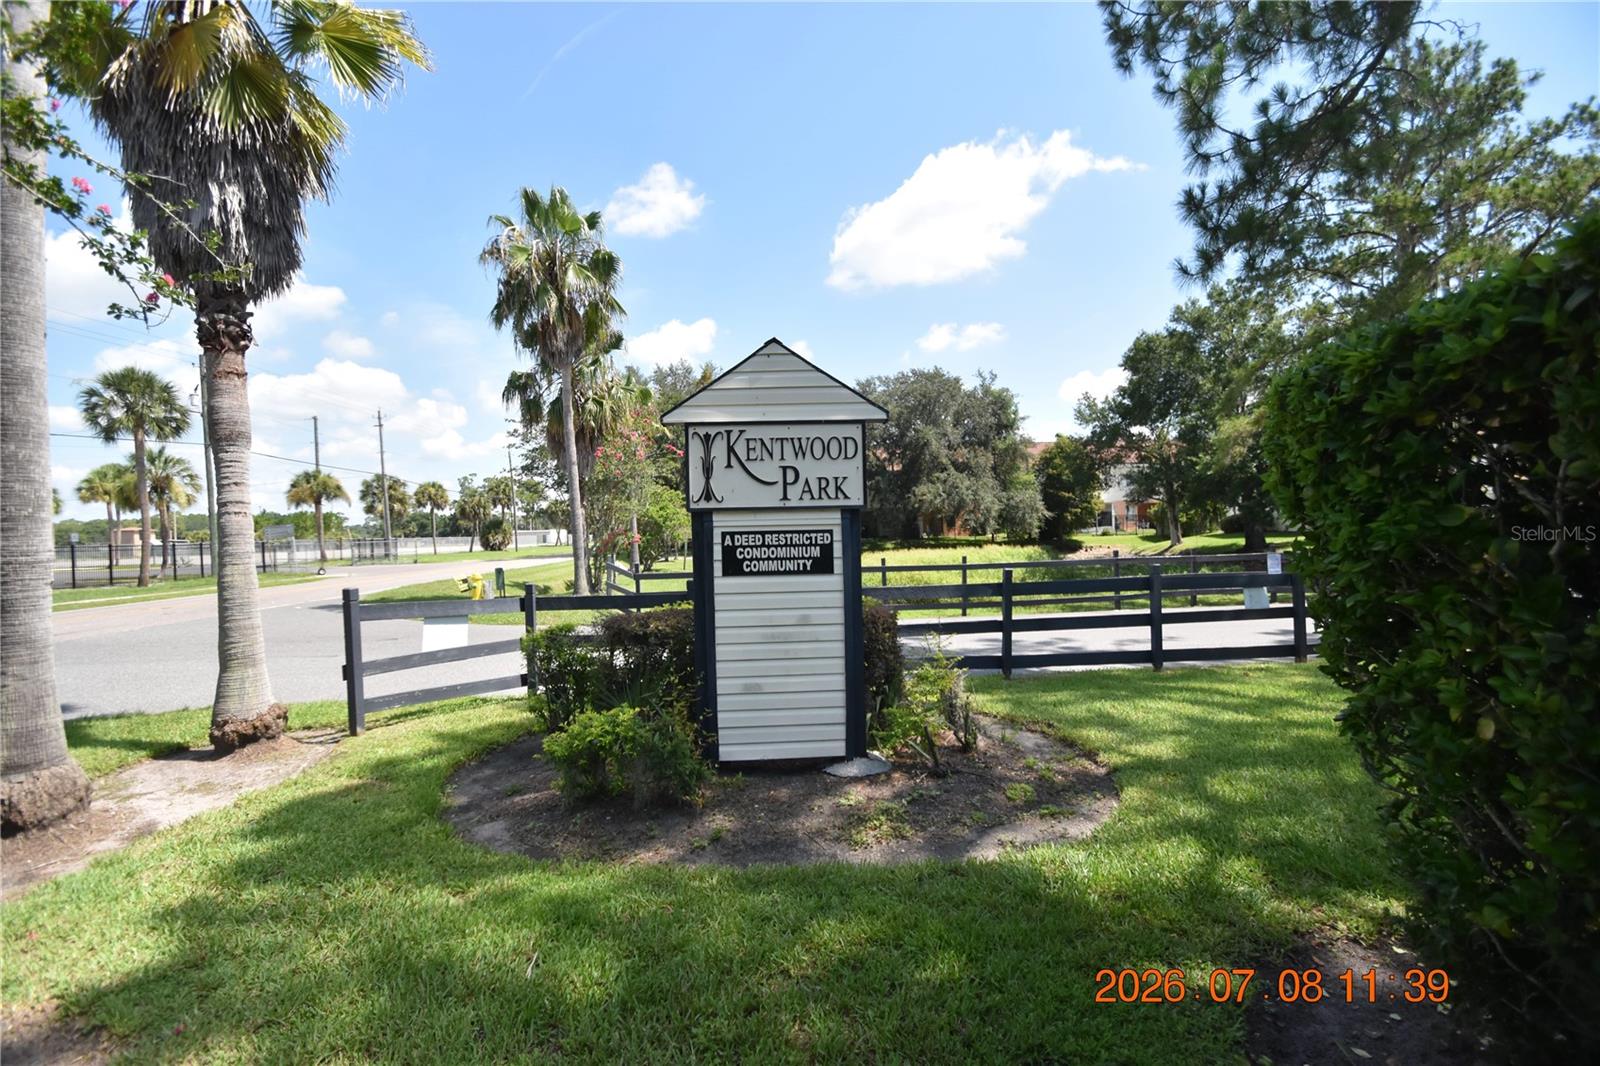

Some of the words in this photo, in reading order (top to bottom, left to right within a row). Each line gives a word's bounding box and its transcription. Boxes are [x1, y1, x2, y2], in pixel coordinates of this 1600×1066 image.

[724, 429, 859, 486] KENTWOOD
[778, 465, 851, 501] PARK
[724, 534, 733, 546] A
[734, 534, 763, 545] DEED
[765, 533, 831, 545] RESTRICTED
[736, 546, 821, 559] CONDOMINIUM
[743, 559, 813, 572] COMMUNITY
